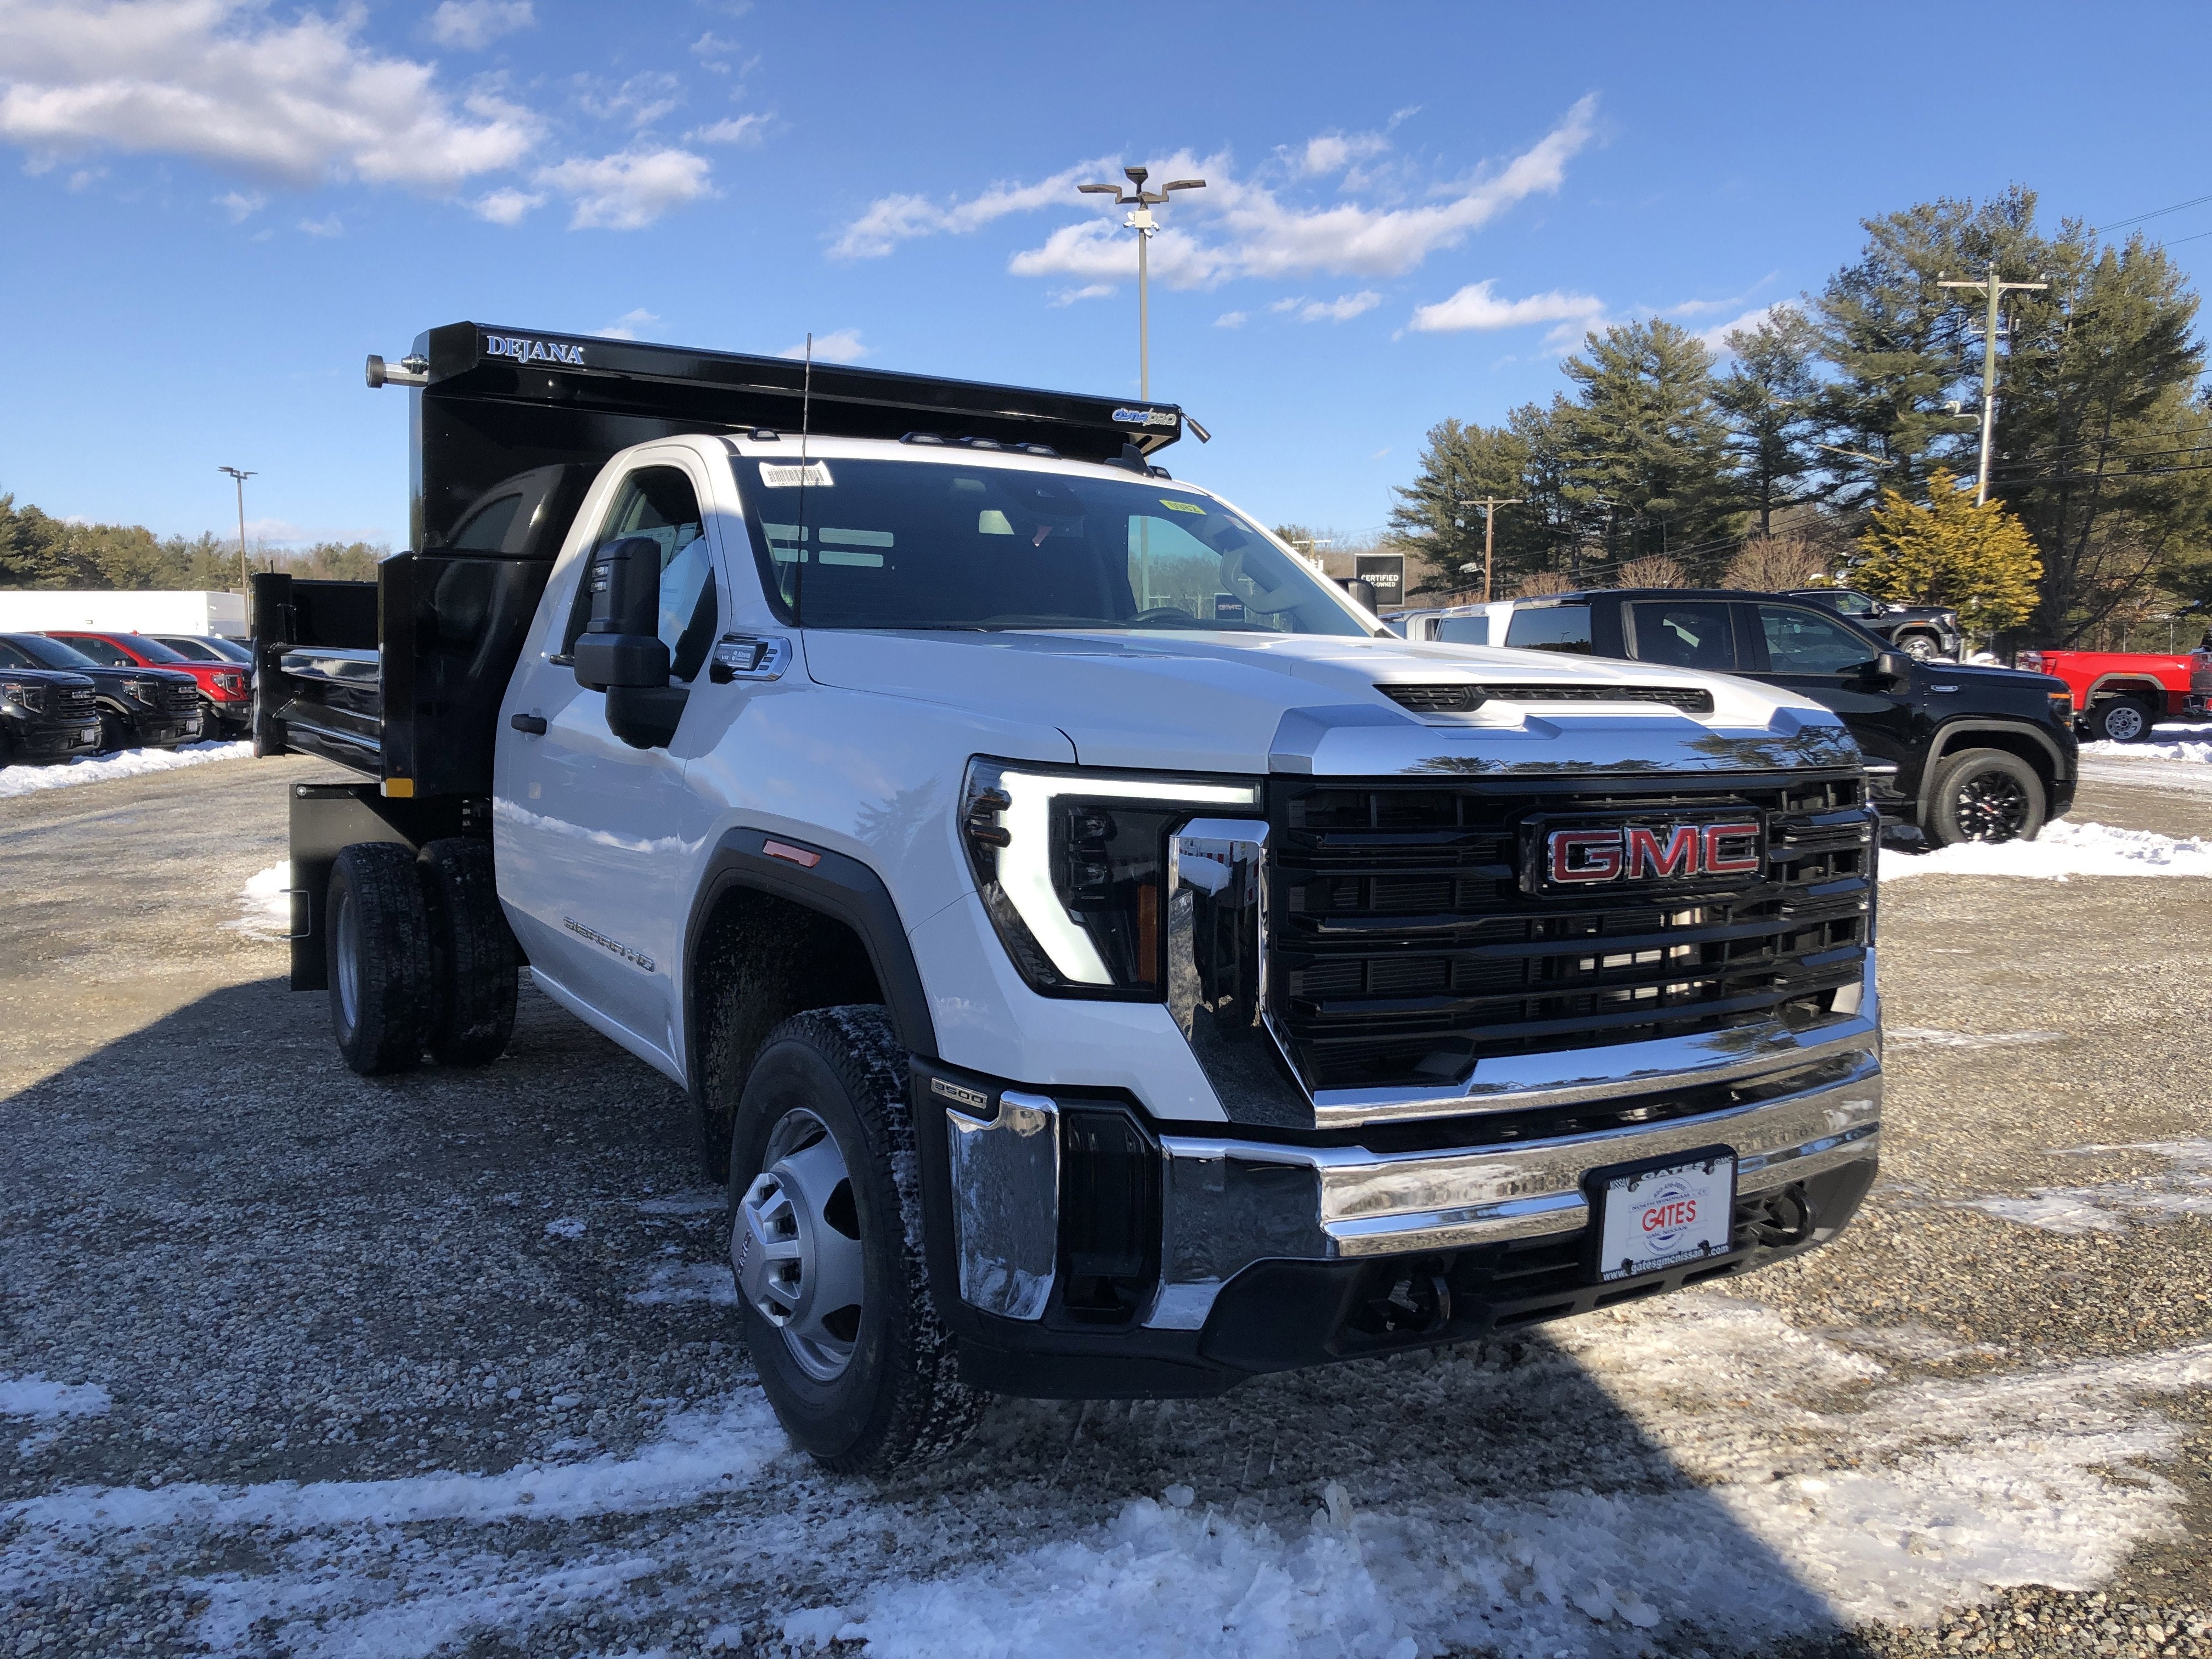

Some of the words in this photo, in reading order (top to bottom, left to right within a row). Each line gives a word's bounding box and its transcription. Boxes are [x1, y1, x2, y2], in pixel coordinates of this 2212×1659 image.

[487, 335, 584, 364] DEJANA
[1547, 822, 1760, 883] GMC
[934, 1082, 984, 1104] 3500
[1641, 1161, 1706, 1181] GATES
[1714, 1156, 1734, 1166] GMC
[1641, 1199, 1696, 1232] GATES
